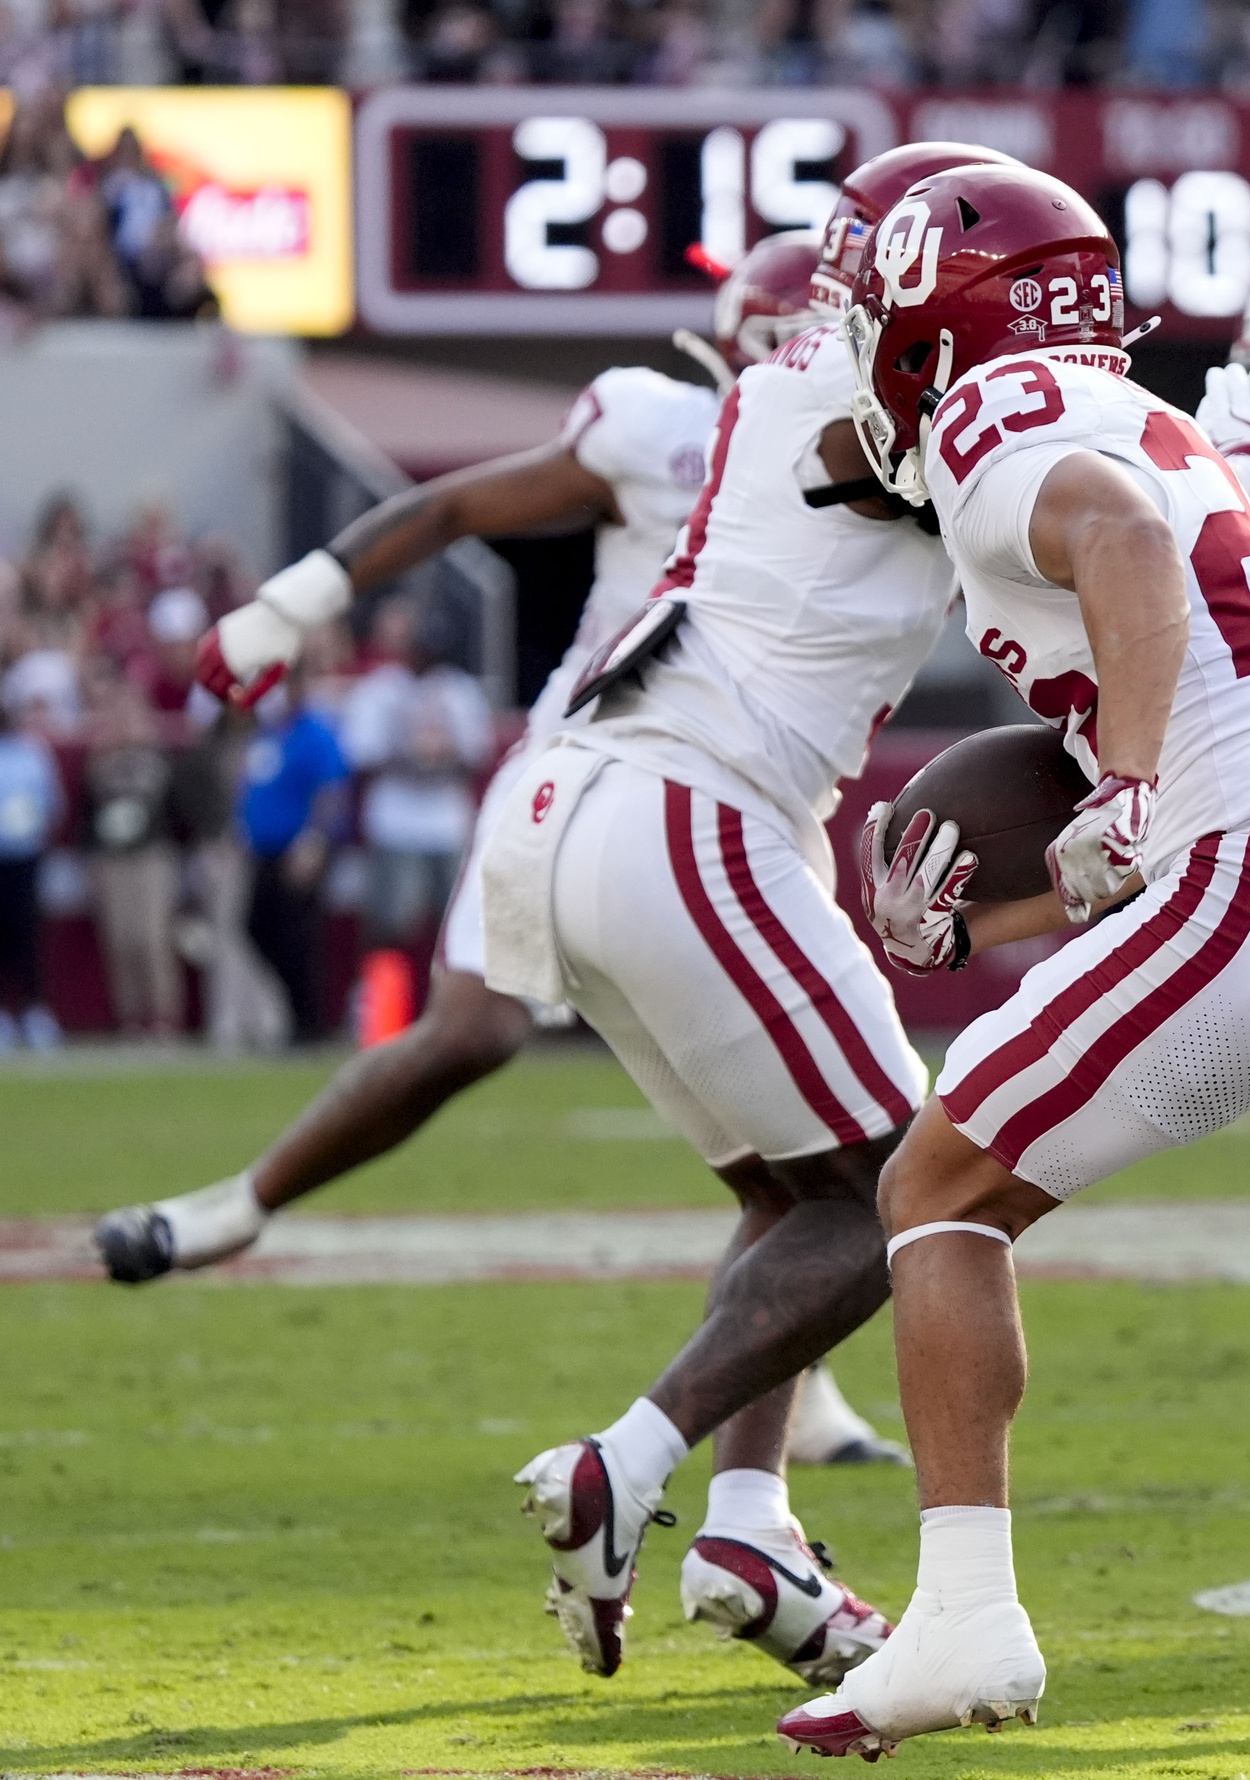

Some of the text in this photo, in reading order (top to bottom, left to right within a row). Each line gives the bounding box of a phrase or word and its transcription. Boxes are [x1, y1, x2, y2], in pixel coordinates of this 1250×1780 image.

[505, 116, 848, 289] 2:15
[875, 201, 944, 308] OU
[1012, 281, 1039, 308] SEC
[1048, 274, 1111, 325] 23
[931, 360, 1066, 486] 23
